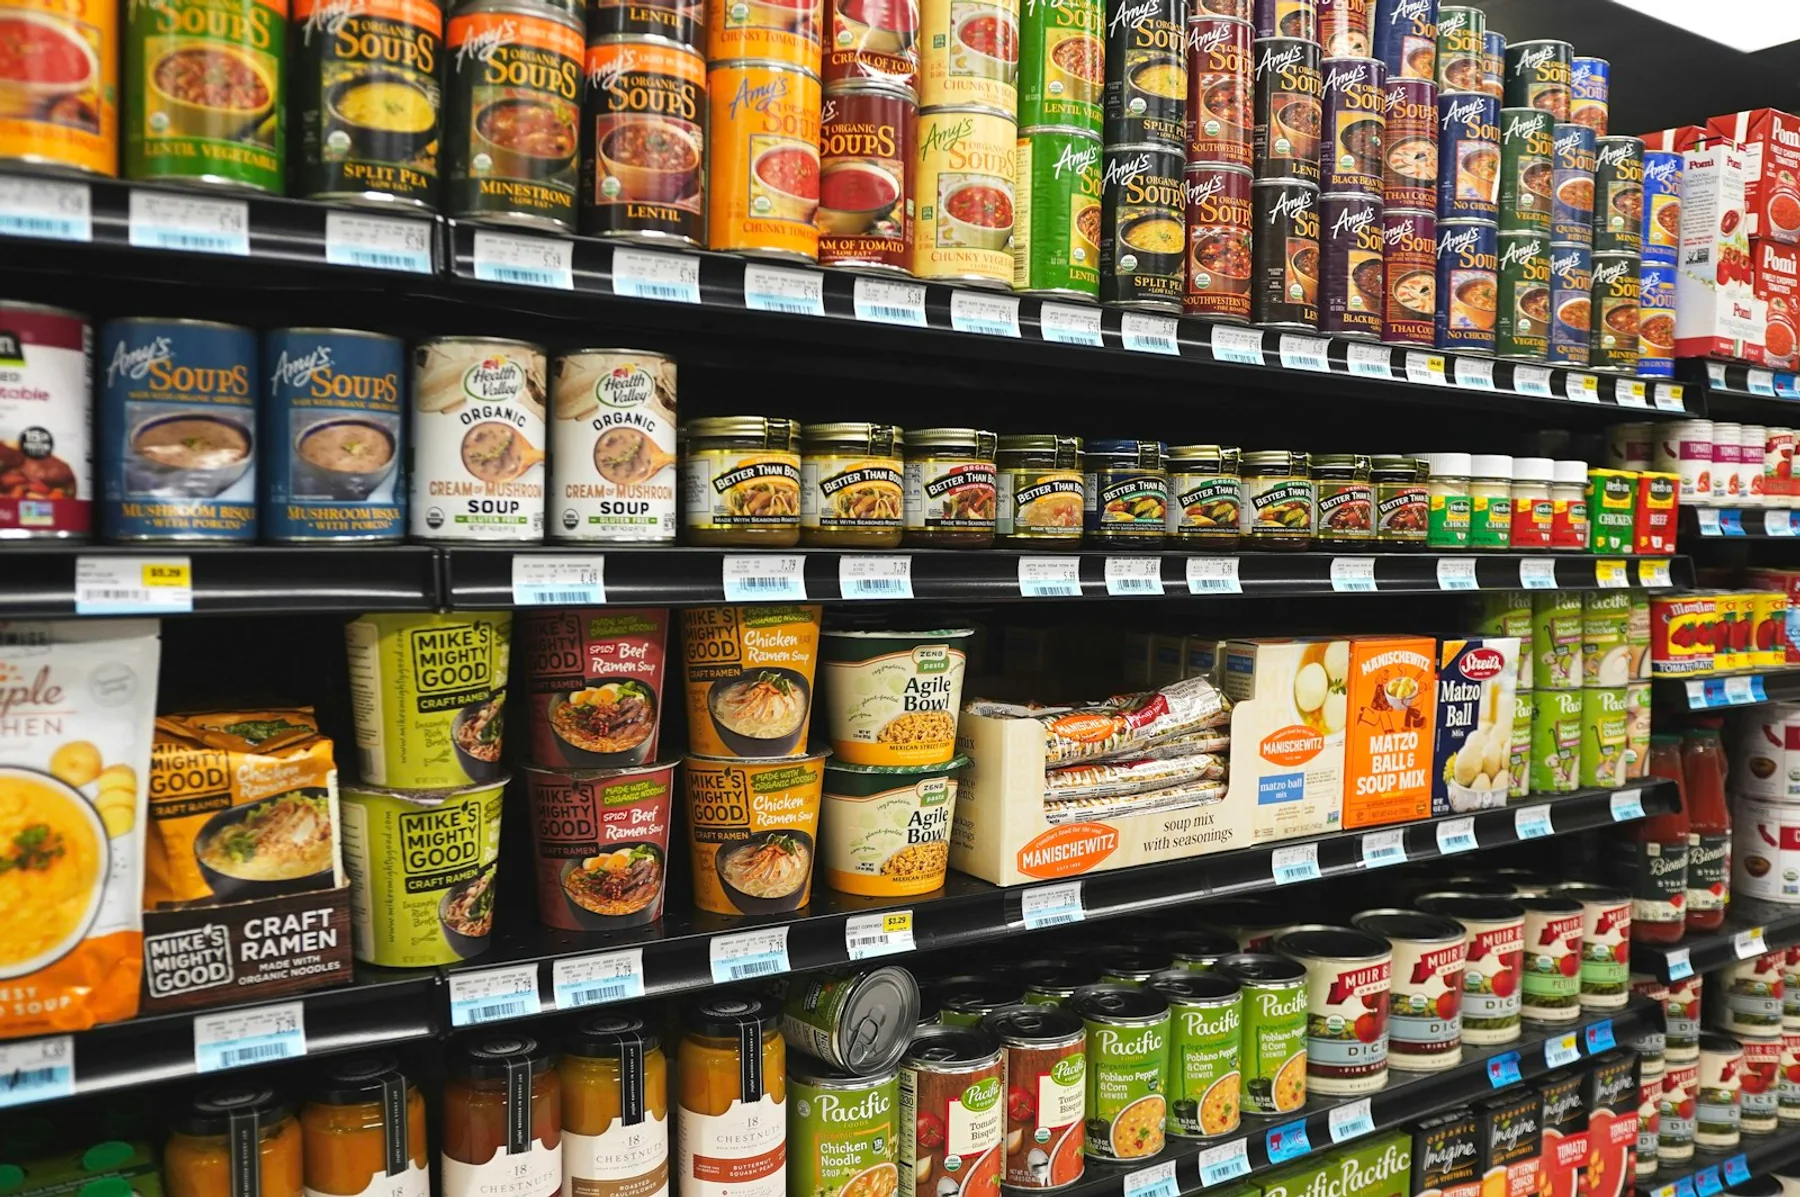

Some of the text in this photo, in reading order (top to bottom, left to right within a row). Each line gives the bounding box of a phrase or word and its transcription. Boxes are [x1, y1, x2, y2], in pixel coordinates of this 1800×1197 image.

[630, 7, 684, 28] LENTIL
[1255, 45, 1304, 81] Amy's
[485, 48, 577, 100] SOUPS
[1321, 65, 1367, 99] Amy's
[608, 77, 696, 120] SOUPS
[1044, 102, 1081, 115] LENTIL
[1442, 98, 1486, 131] Amy's
[831, 123, 876, 134] ORGANIC
[1503, 114, 1545, 145] Amy's
[921, 118, 974, 162] Amy's
[343, 161, 429, 189] SPLIT PEA
[480, 180, 573, 208] MINESTRONE
[1384, 192, 1409, 201] THAI
[627, 204, 681, 222] LENTIL
[1269, 191, 1313, 224] Amy's
[1331, 206, 1375, 239] Amy's
[839, 240, 904, 254] OF TOMATO
[931, 251, 979, 263] CHUNKY
[1500, 239, 1542, 271] Amy's
[1134, 276, 1184, 291] SPLIT PEA
[150, 359, 249, 395] SOUPS
[270, 346, 333, 396] Amy's
[473, 368, 517, 385] Health
[311, 367, 398, 403] SOUPS
[482, 381, 520, 398] Valley
[604, 375, 646, 392] Health
[613, 388, 648, 404] Valley
[459, 405, 527, 428] ORGANIC
[592, 412, 656, 433] ORGANIC
[714, 464, 783, 490] BETTER THAN
[823, 470, 888, 495] BETTER THAN
[928, 472, 988, 496] BETTER THAN
[1017, 482, 1074, 504] BETTER THAN
[1103, 482, 1158, 503] BETTER THAN
[1182, 486, 1234, 507] BETTER THAN
[1255, 488, 1306, 508] BETTER THAN
[1320, 491, 1366, 511] BETTER THAN
[468, 499, 520, 515] SOUP
[600, 501, 650, 516] SOUP
[1380, 494, 1427, 513] BETTER THAN
[1599, 513, 1633, 526] CHICKEN
[1650, 514, 1669, 526] BEEF
[150, 568, 182, 579] $5.29
[781, 559, 797, 572] 7.79
[893, 562, 908, 574] 7.79
[417, 626, 489, 652] MIKE'S
[744, 630, 798, 648] Chicken
[419, 646, 488, 669] MIGHTY
[589, 642, 649, 659] SPICY Beef
[923, 662, 945, 671] pasta
[1361, 650, 1431, 677] MANISCHEWITZ
[1461, 652, 1502, 672] Streit's
[422, 662, 488, 689] GOOD
[903, 676, 951, 698] Agile
[1440, 681, 1482, 703] Matzo
[903, 693, 950, 711] Bowl
[1446, 704, 1473, 728] Ball
[1370, 731, 1418, 755] MATZO
[1451, 729, 1464, 738] Mix
[1263, 737, 1323, 755] MANISCHEWITZ
[151, 754, 226, 775] MIGHTY
[150, 769, 225, 794] GOOD
[690, 772, 741, 791] MIKE'S
[754, 773, 818, 791] ORGANIC NOODLES
[756, 768, 799, 783] MADE WITH
[1260, 781, 1288, 792] matzo
[1288, 777, 1303, 789] ball
[1356, 774, 1397, 796] SOUP
[1400, 769, 1426, 790] MIX
[692, 789, 743, 806] MIGHTY
[753, 795, 804, 812] Chicken
[926, 793, 945, 804] pasta
[406, 807, 478, 834] MIKE'S
[603, 806, 660, 823] SPICY Beef
[694, 804, 745, 823] GOOD
[907, 807, 949, 830] Agile
[1163, 813, 1215, 833] soup mix
[408, 824, 477, 850] MIGHTY
[907, 825, 947, 845] Bowl
[1143, 827, 1233, 853] with seasonings
[410, 844, 478, 870] GOOD
[1022, 833, 1116, 870] MANISCHEWITZ
[408, 868, 478, 891] CRAFT RAMEN
[892, 873, 936, 883] MEXICAN STREET
[243, 908, 335, 940] CRAFT
[888, 917, 906, 926] $3.29
[1552, 919, 1577, 934] MUIR
[151, 926, 225, 958] MIKE'S
[240, 928, 339, 963] RAMEN
[1482, 932, 1513, 948] MUIR
[152, 948, 226, 974] MIGHTY
[259, 955, 322, 973] MADE WITH
[1427, 950, 1457, 970] MUIR
[156, 964, 229, 994] GOOD
[238, 961, 342, 987] ORGANIC NOODLES
[1345, 970, 1381, 988] MUIR
[1181, 1007, 1240, 1037] Pacific
[1096, 1028, 1163, 1057] Pacific
[1262, 1033, 1291, 1042] Poblano
[1268, 1043, 1287, 1051] Corn
[1186, 1045, 1239, 1062] Poblano Pepper
[1100, 1068, 1160, 1083] Poblano Pepper
[1187, 1071, 1214, 1079] CHOWDER
[814, 1091, 891, 1124] Pacific
[1058, 1093, 1083, 1106] Tomato
[1060, 1102, 1083, 1115] Bisque
[746, 1117, 759, 1128] 18
[969, 1117, 998, 1132] Tomato
[1610, 1118, 1638, 1139] TOMATO
[716, 1124, 780, 1144] CHESTNUTS
[971, 1128, 997, 1142] Bisque
[1491, 1120, 1538, 1150] Imagine
[596, 1142, 663, 1165] CHESTNUTS
[820, 1142, 868, 1154] Chicken
[1557, 1138, 1588, 1161] TOMATO
[733, 1158, 772, 1171] BUTTERNUT
[821, 1154, 861, 1166] Noodle
[729, 1163, 774, 1178] SQUASH PEAR
[821, 1169, 841, 1178] SOUP
[1341, 1145, 1412, 1197] Pacific
[480, 1172, 552, 1195] CHESTNUTS
[619, 1179, 650, 1191] ROASTED
